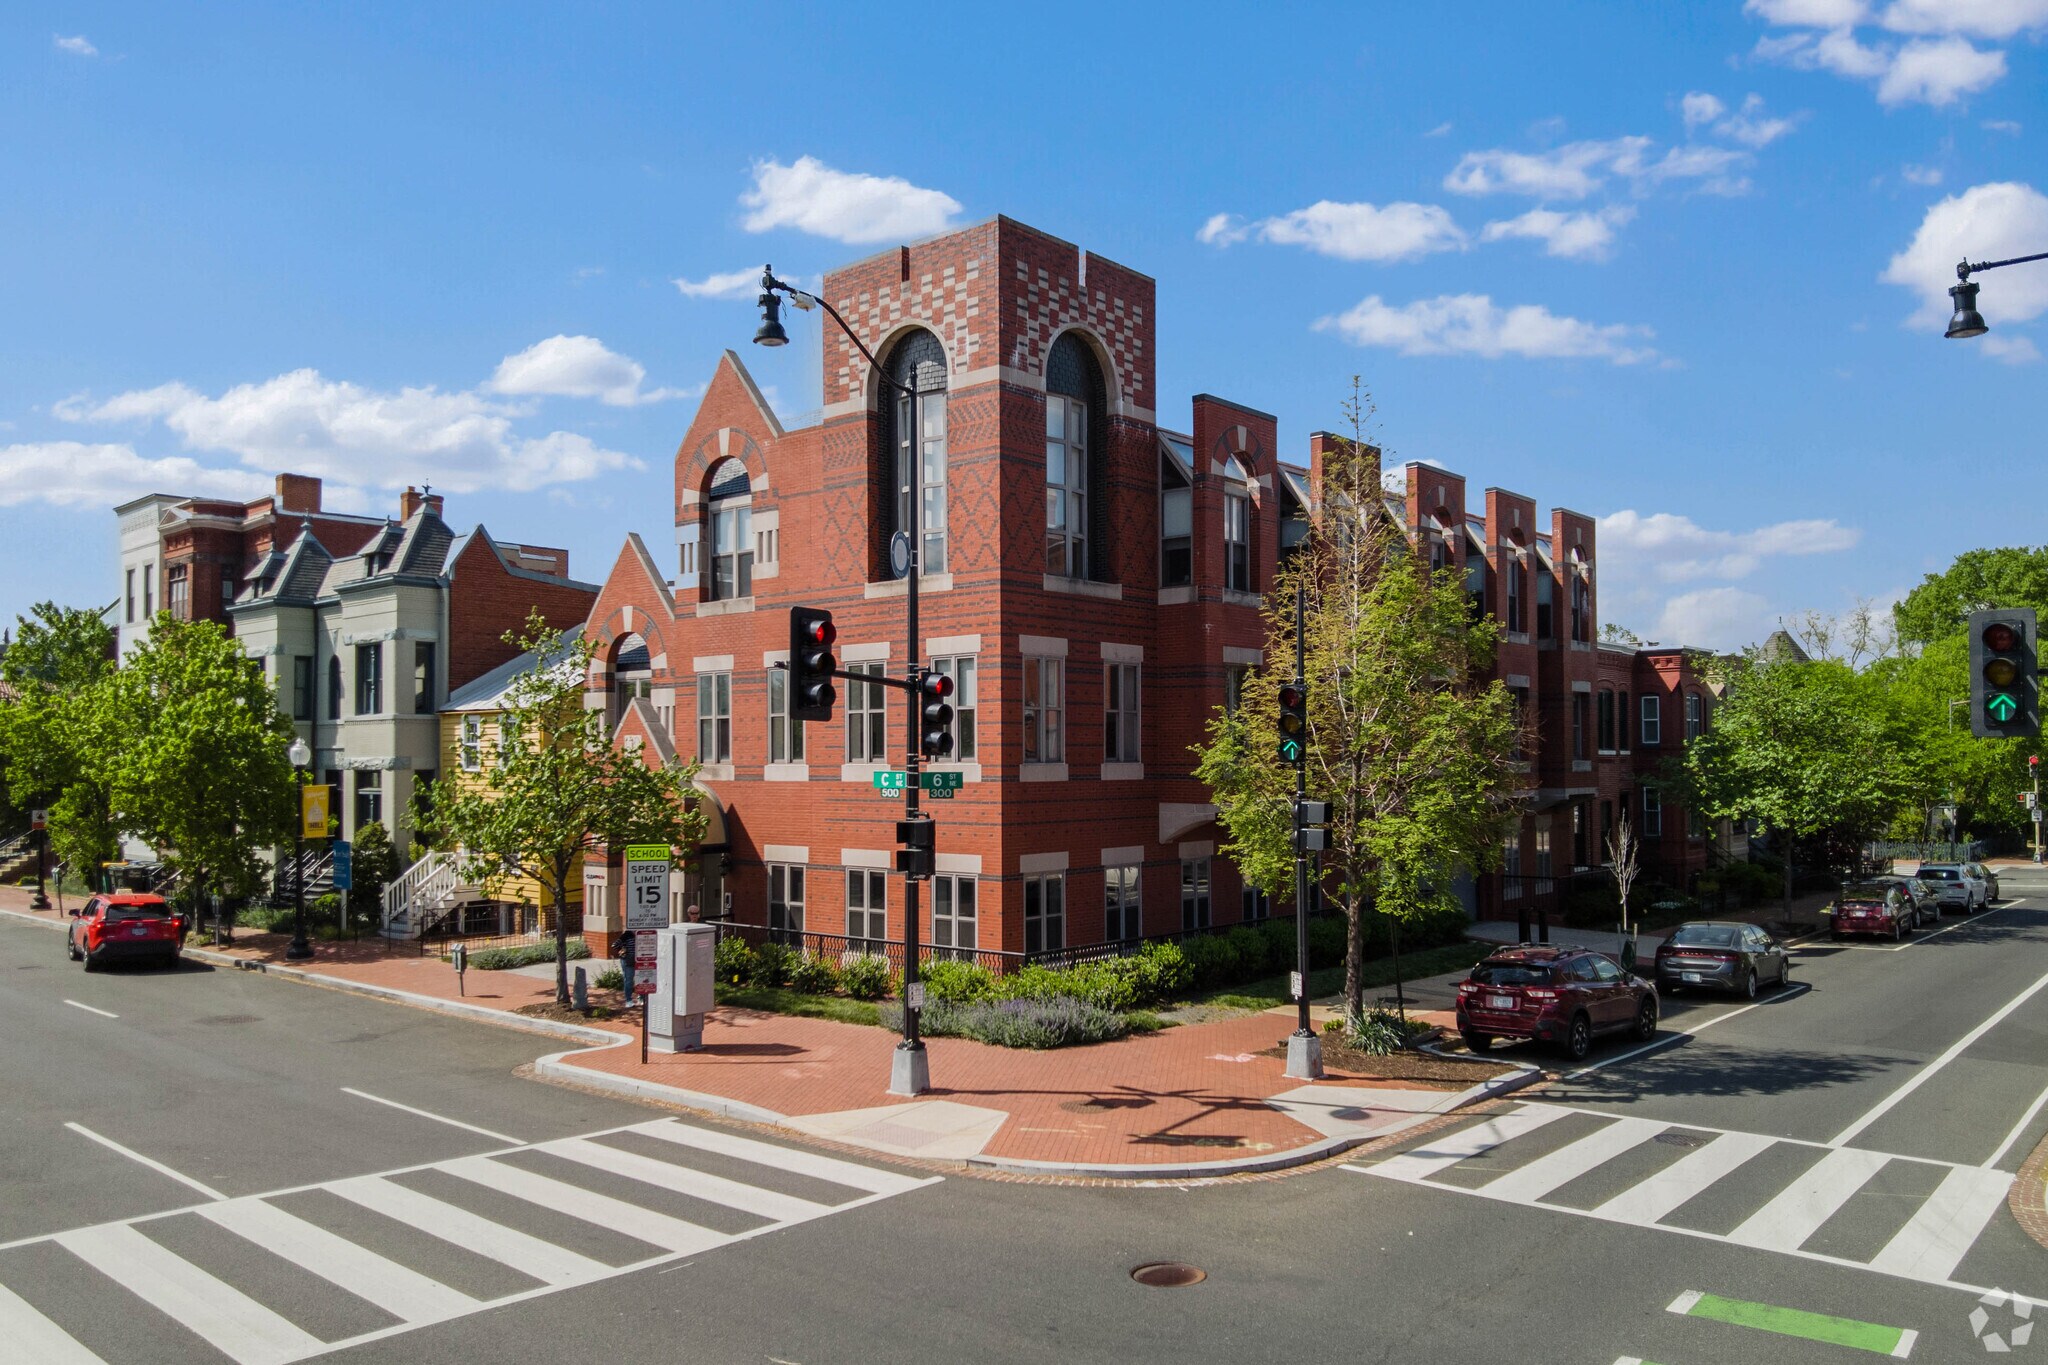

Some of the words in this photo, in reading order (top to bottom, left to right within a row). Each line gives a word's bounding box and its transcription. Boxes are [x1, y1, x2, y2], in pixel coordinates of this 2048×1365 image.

[881, 773, 889, 786] C
[933, 773, 942, 787] 6
[881, 788, 899, 797] 500
[930, 788, 952, 798] 300
[629, 849, 668, 858] SCHOOL
[631, 865, 666, 873] SPEED
[634, 875, 662, 883] LIMIT
[636, 886, 661, 904] 15
